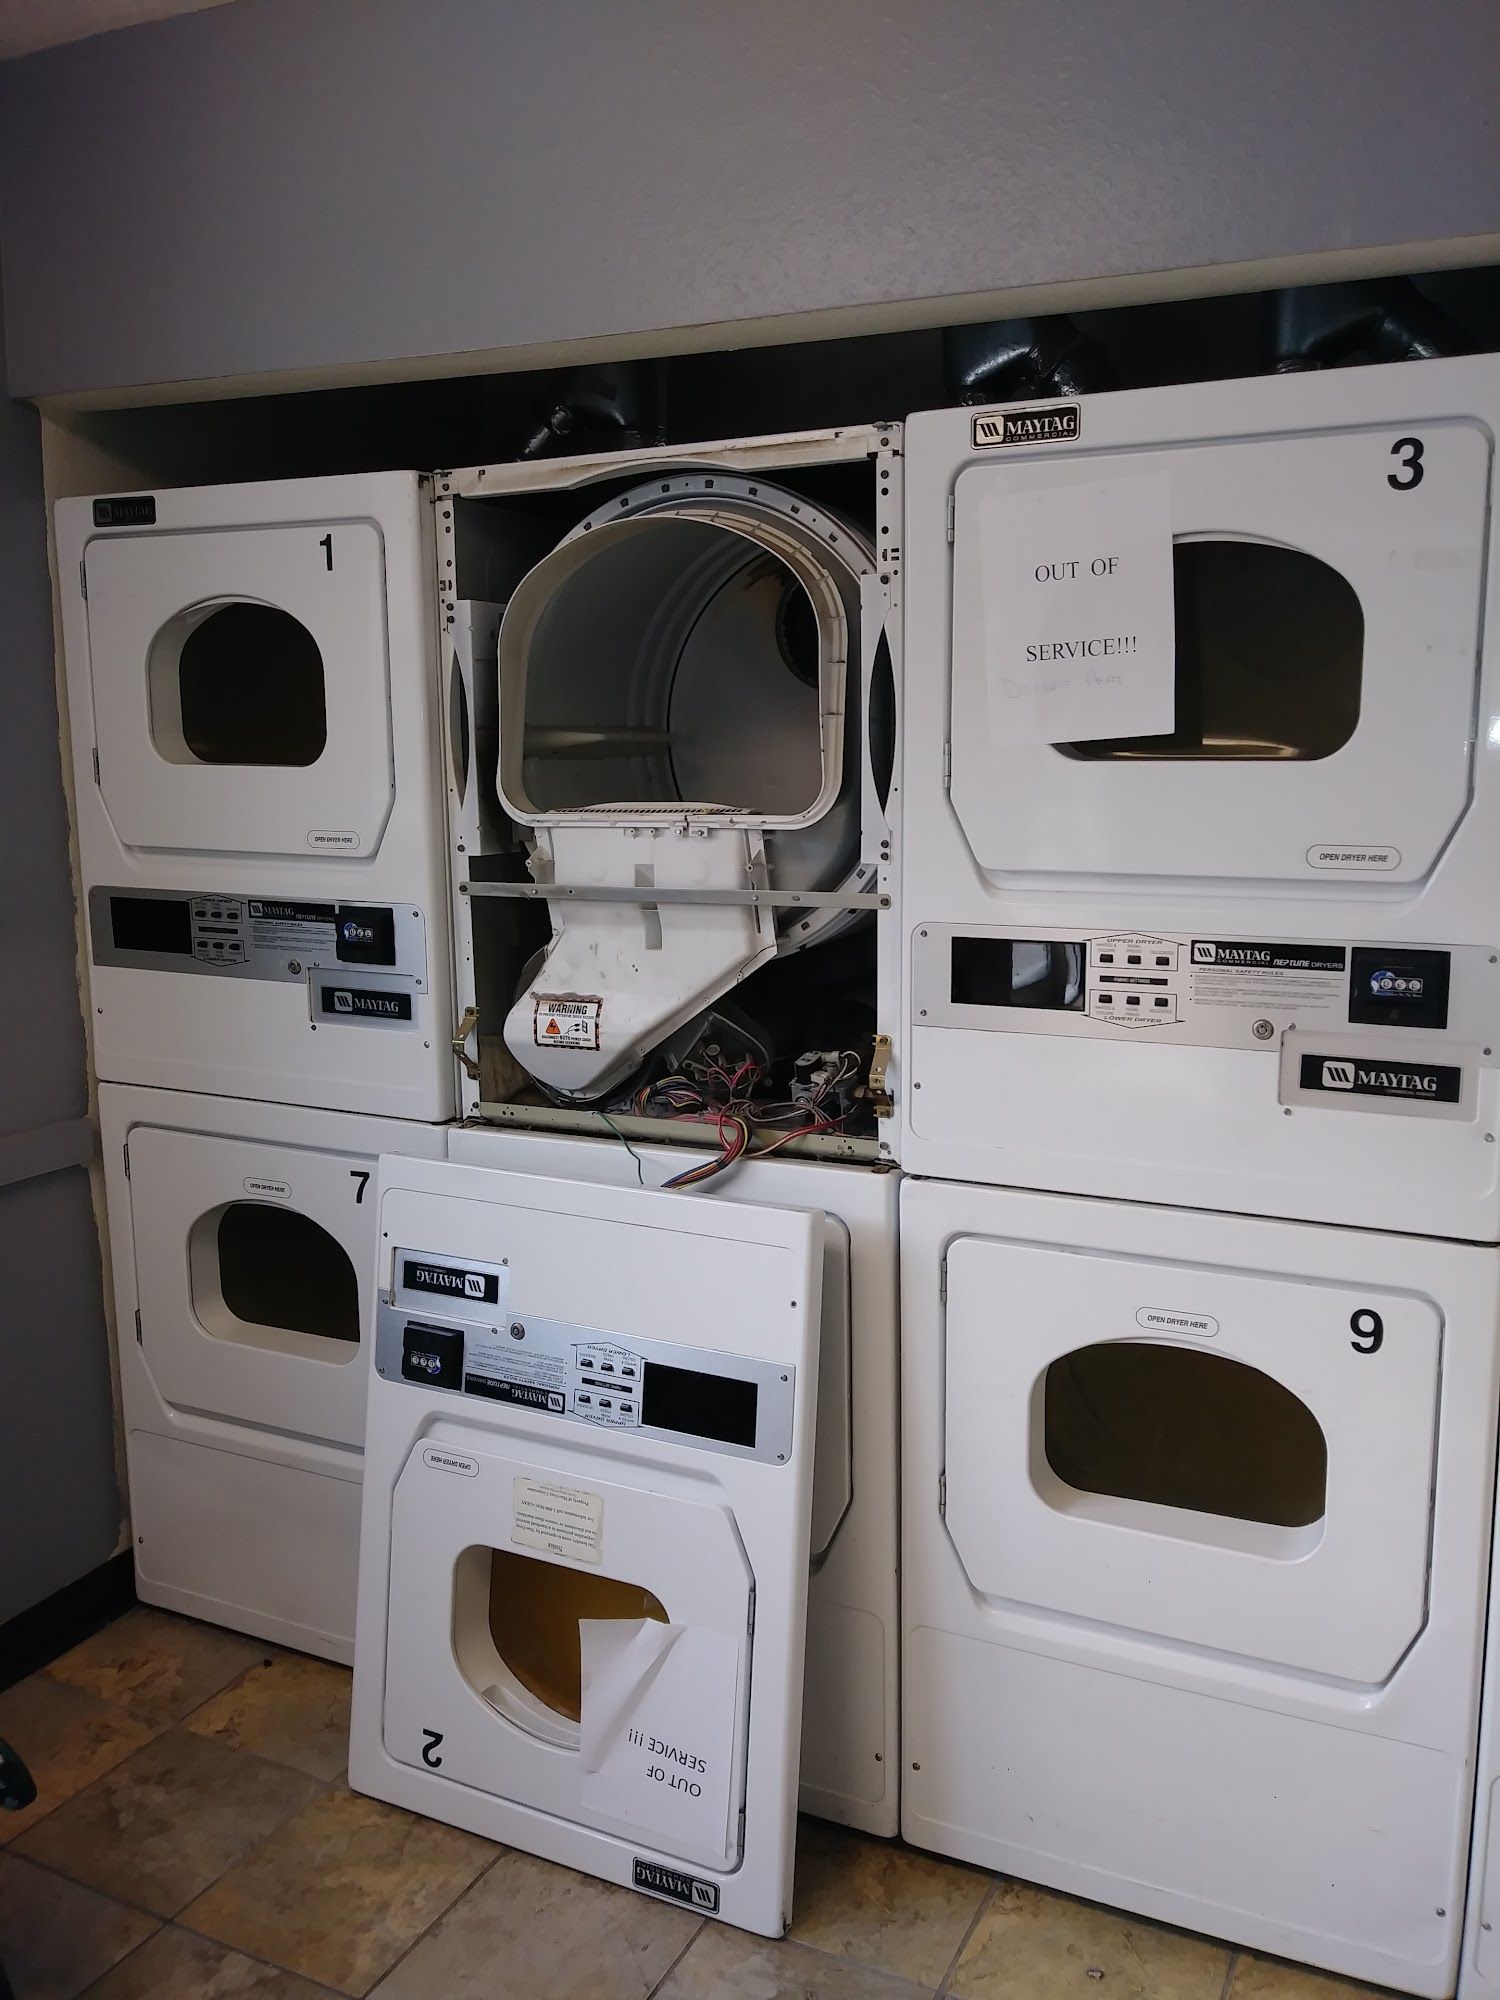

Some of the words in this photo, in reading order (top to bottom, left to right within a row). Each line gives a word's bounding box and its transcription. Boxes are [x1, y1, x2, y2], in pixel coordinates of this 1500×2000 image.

[1006, 415, 1075, 435] MAYTAG
[1005, 431, 1075, 442] COMMERCIAL
[1388, 437, 1424, 490] 3
[320, 534, 333, 571] 1
[1035, 561, 1080, 582] OUT
[1091, 557, 1119, 576] OF
[1026, 635, 1137, 662] SERVICE!!!
[1319, 853, 1340, 861] OPEN
[1340, 854, 1366, 862] DRYER
[1367, 854, 1389, 862] HERE
[264, 906, 294, 916] MAYTAG
[1217, 949, 1271, 962] MAYTAG
[1273, 959, 1310, 968] NEPTUNE
[354, 998, 399, 1012] MAYTAG
[548, 1004, 588, 1015] WARNING
[1357, 1070, 1437, 1091] MAYTAG
[350, 1170, 370, 1204] 7
[416, 1270, 463, 1289] MAYTAG
[1147, 1314, 1166, 1324] OPEN
[1166, 1317, 1189, 1327] DRYER
[1189, 1320, 1208, 1330] HERE
[1350, 1308, 1384, 1354] 9
[587, 1345, 608, 1353] DRYER
[609, 1349, 630, 1357] LOWER
[511, 1388, 547, 1404] MAYTAG
[605, 1418, 626, 1426] UPPER
[430, 1455, 442, 1463] HERE
[443, 1459, 458, 1467] DRYER
[459, 1463, 471, 1471] OPEN
[422, 1728, 443, 1768] 2
[647, 1737, 707, 1773] SERVICE
[646, 1765, 665, 1782] OF
[668, 1774, 701, 1797] OUT
[636, 1866, 690, 1895] MAYTAG
